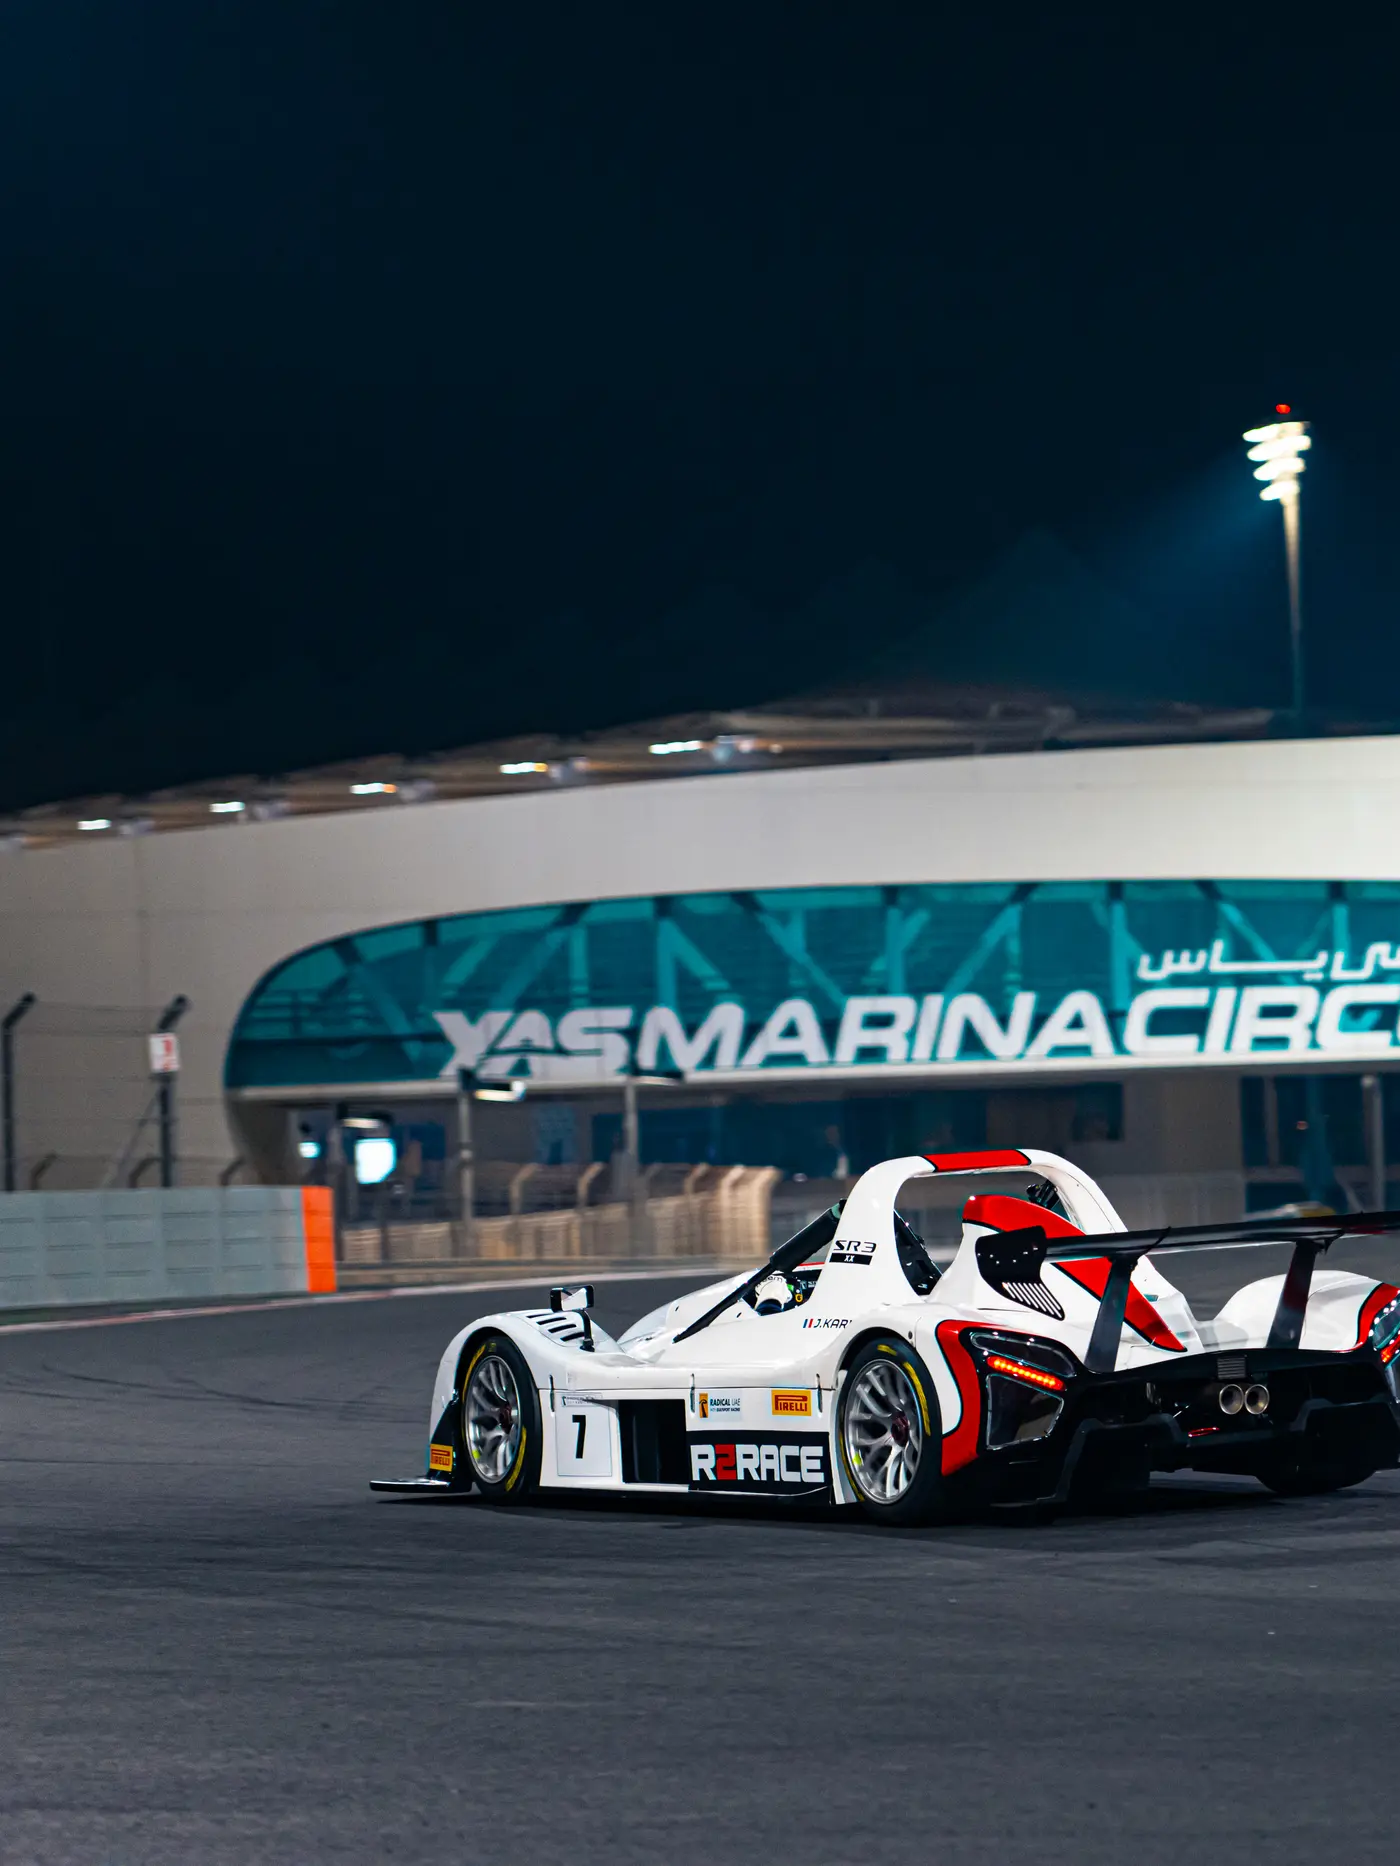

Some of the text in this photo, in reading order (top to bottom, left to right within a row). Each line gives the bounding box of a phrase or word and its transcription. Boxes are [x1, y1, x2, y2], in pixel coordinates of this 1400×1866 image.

[833, 1240, 877, 1253] SR3
[813, 1319, 852, 1329] J.KAR
[710, 1398, 741, 1406] RADICAL UAE
[774, 1395, 808, 1412] PIRELLI
[572, 1415, 586, 1459] 7
[690, 1444, 825, 1483] R2RACE
